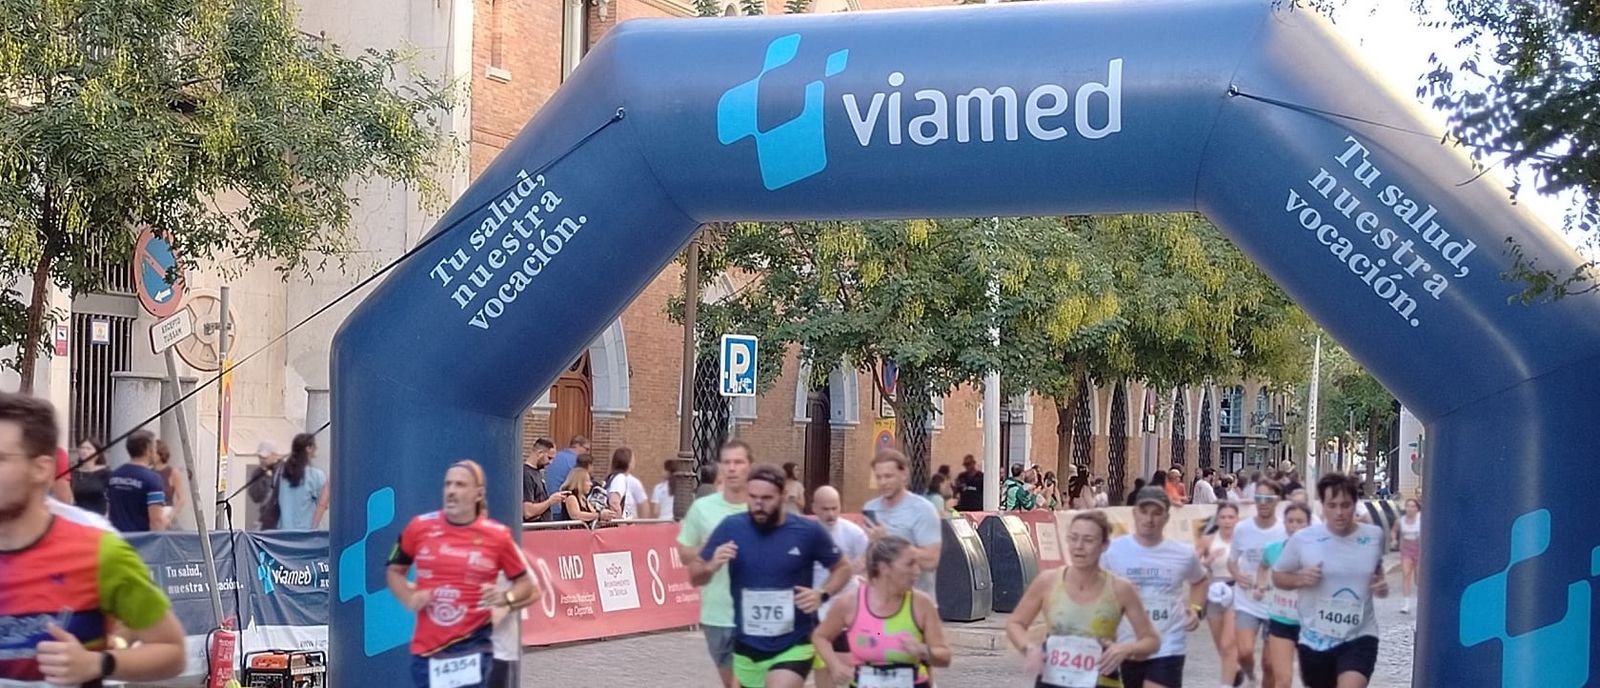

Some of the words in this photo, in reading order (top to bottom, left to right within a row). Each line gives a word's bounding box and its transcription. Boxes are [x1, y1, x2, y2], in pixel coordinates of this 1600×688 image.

[842, 58, 1123, 146] viamed
[1334, 135, 1381, 189] Tu
[1377, 184, 1478, 278] salud,
[429, 248, 471, 288] Tu
[469, 168, 546, 251] salud,
[1308, 167, 1449, 300] nuestra
[450, 190, 563, 310] nuestra
[1284, 188, 1420, 328] vocación.
[468, 214, 588, 331] vocación.
[729, 343, 751, 388] P
[165, 566, 177, 578] Tu
[178, 564, 202, 578] salud,
[271, 565, 312, 585] viamed
[558, 555, 584, 581] IMD
[168, 582, 203, 594] nuestra
[752, 605, 784, 621] 376
[1318, 609, 1360, 626] 14046
[433, 658, 478, 677] 14354
[1049, 649, 1095, 671] 8240
